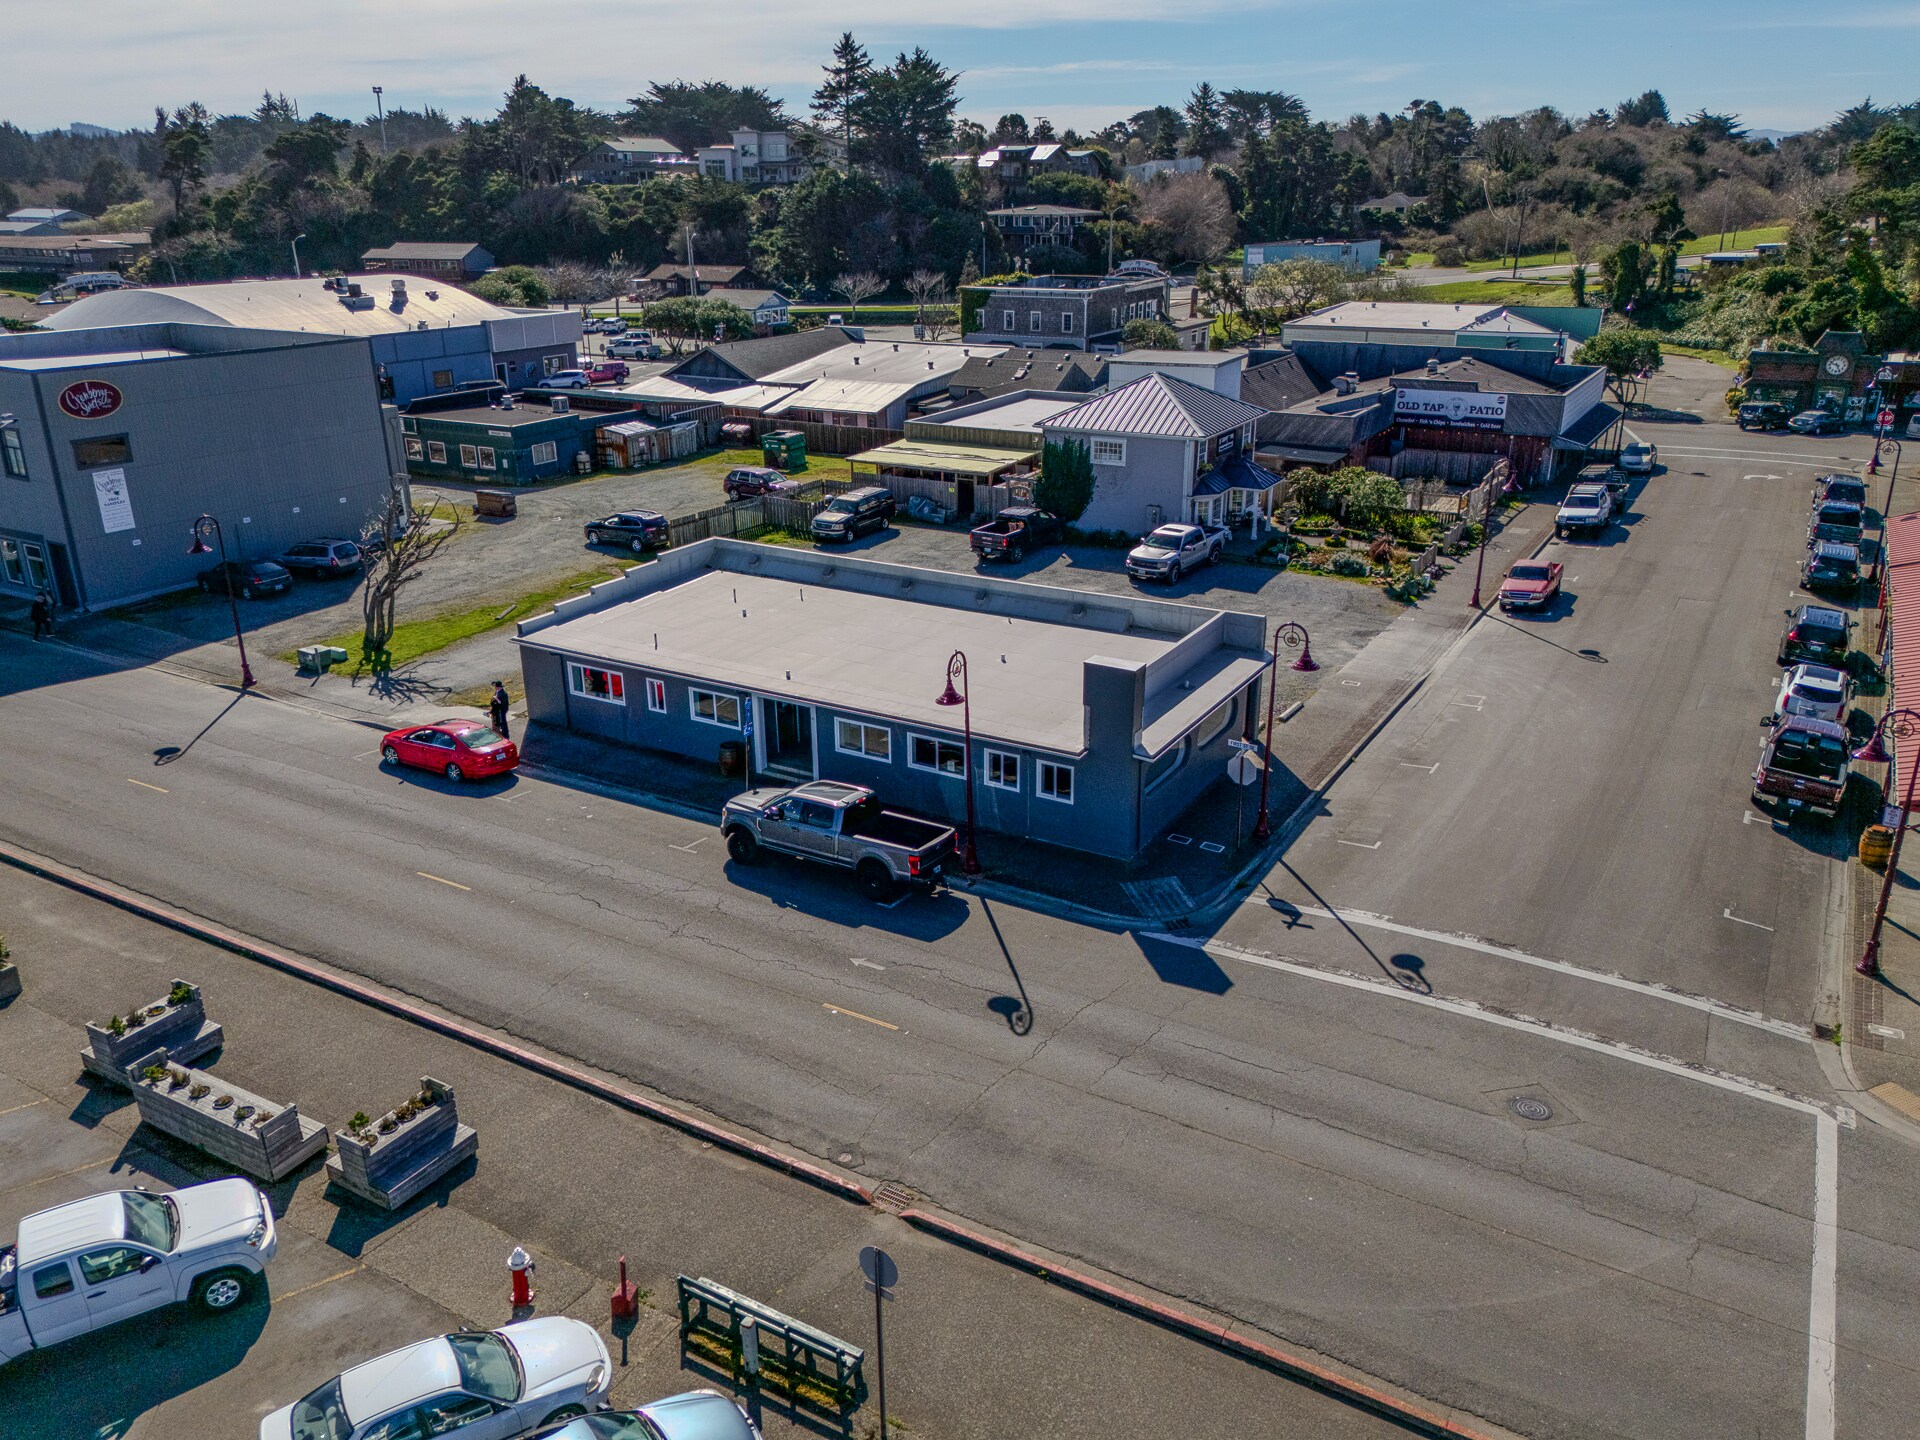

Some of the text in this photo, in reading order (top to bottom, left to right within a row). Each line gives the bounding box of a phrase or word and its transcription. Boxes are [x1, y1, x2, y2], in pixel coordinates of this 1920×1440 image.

[65, 382, 114, 409] Cranberry
[1397, 401, 1504, 416] OLD TAP PATIO
